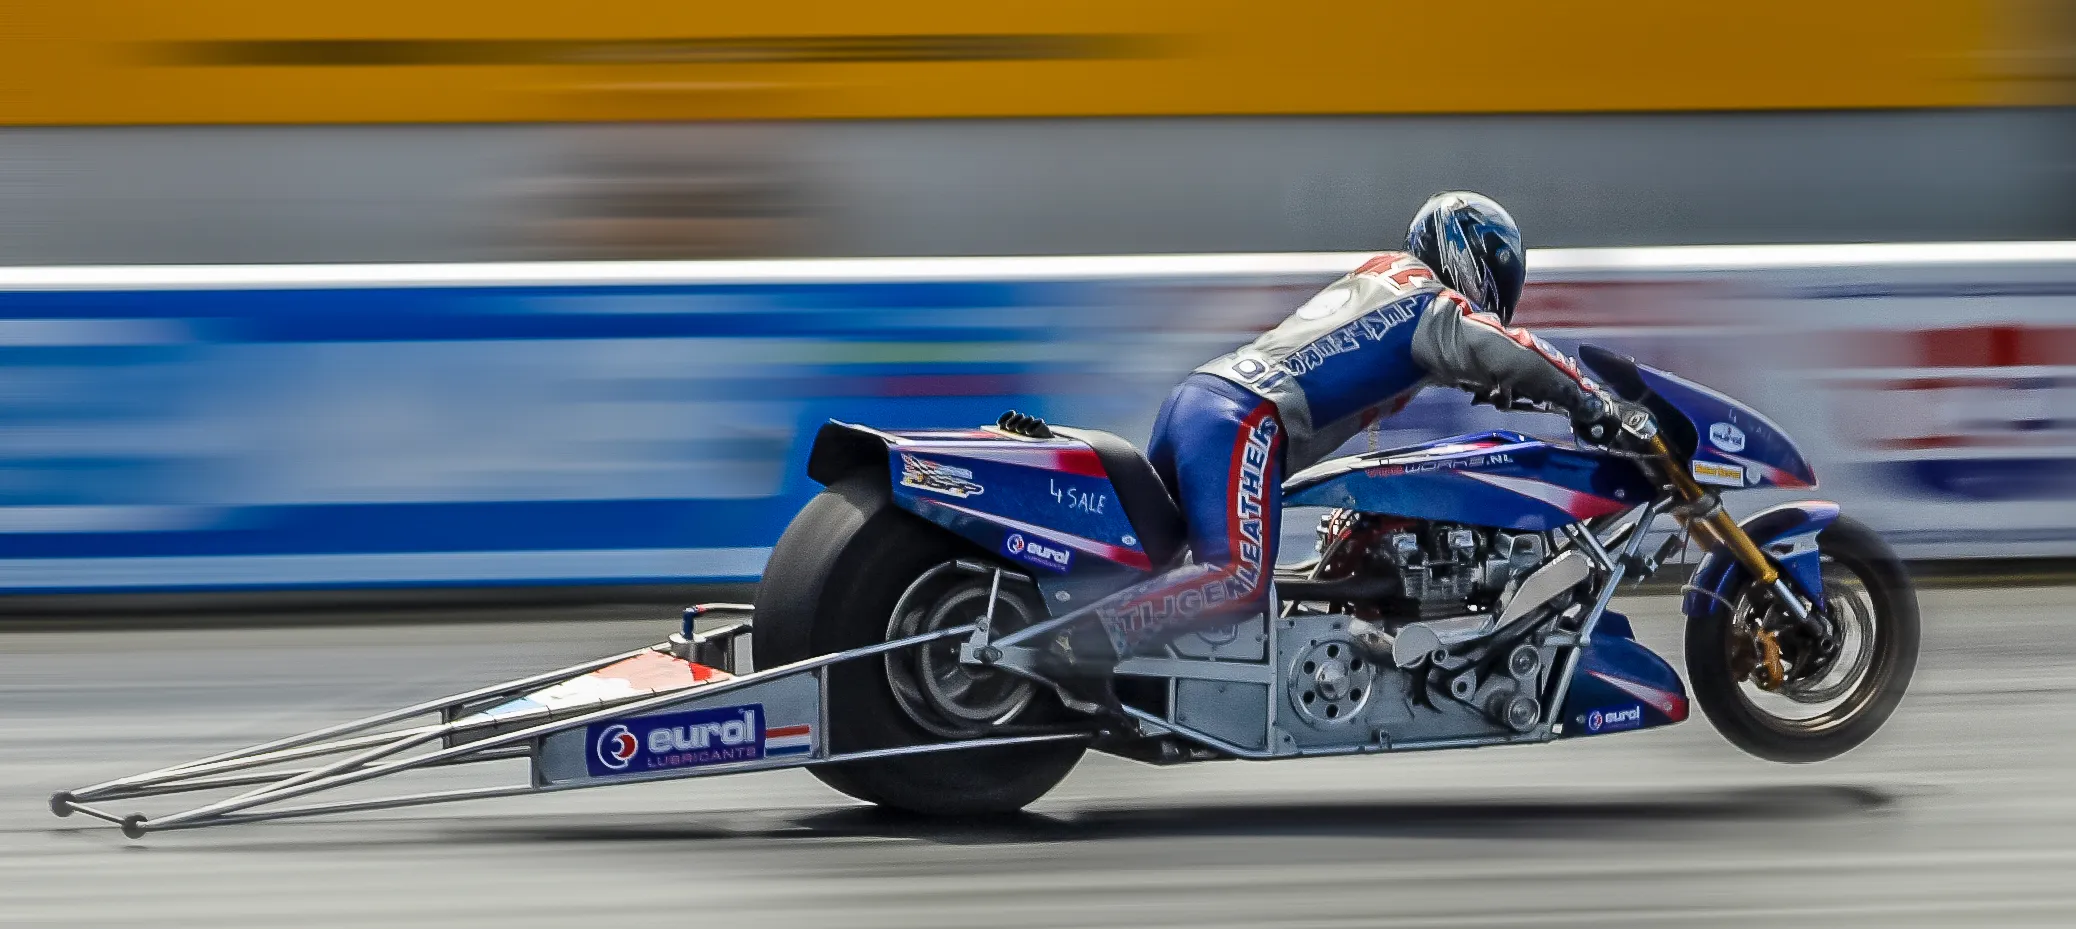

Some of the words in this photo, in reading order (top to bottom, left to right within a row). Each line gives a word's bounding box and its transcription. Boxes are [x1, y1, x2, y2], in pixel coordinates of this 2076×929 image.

[1050, 478, 1062, 504] 4
[1067, 488, 1106, 515] SALE
[1027, 542, 1070, 565] eurol
[1116, 576, 1253, 632] TIJGEN
[1605, 705, 1640, 723] eurol
[648, 709, 755, 753] eurol
[647, 746, 756, 768] LUBRICANTS
